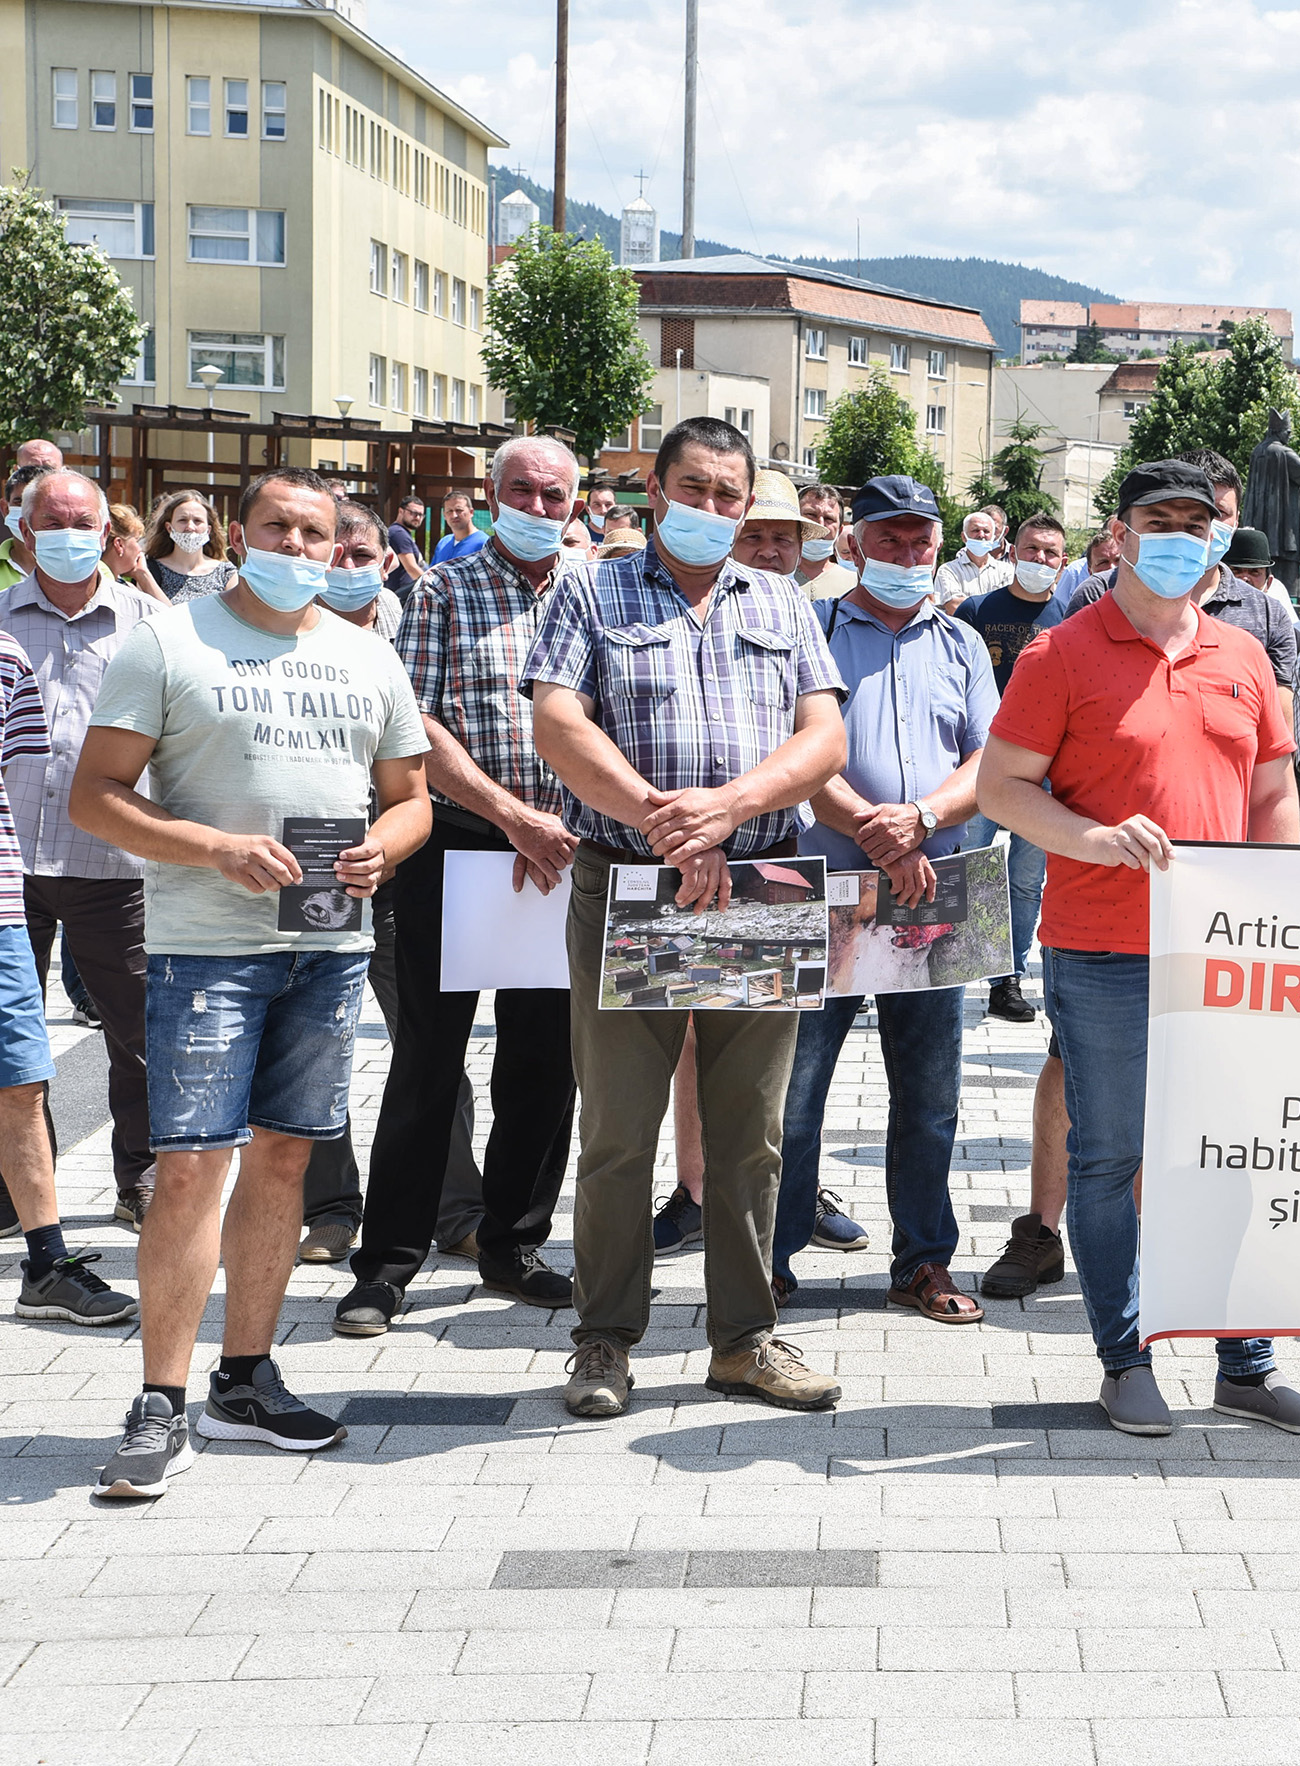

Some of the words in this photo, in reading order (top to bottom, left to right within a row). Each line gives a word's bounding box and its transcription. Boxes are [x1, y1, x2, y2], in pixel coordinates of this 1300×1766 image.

[984, 624, 1015, 633] RACER
[230, 658, 271, 677] DRY
[281, 660, 350, 685] GOODS
[211, 685, 273, 714] TOM
[283, 691, 374, 724] TAILOR
[253, 722, 346, 750] MCMLXII
[1268, 1189, 1300, 1230] și
